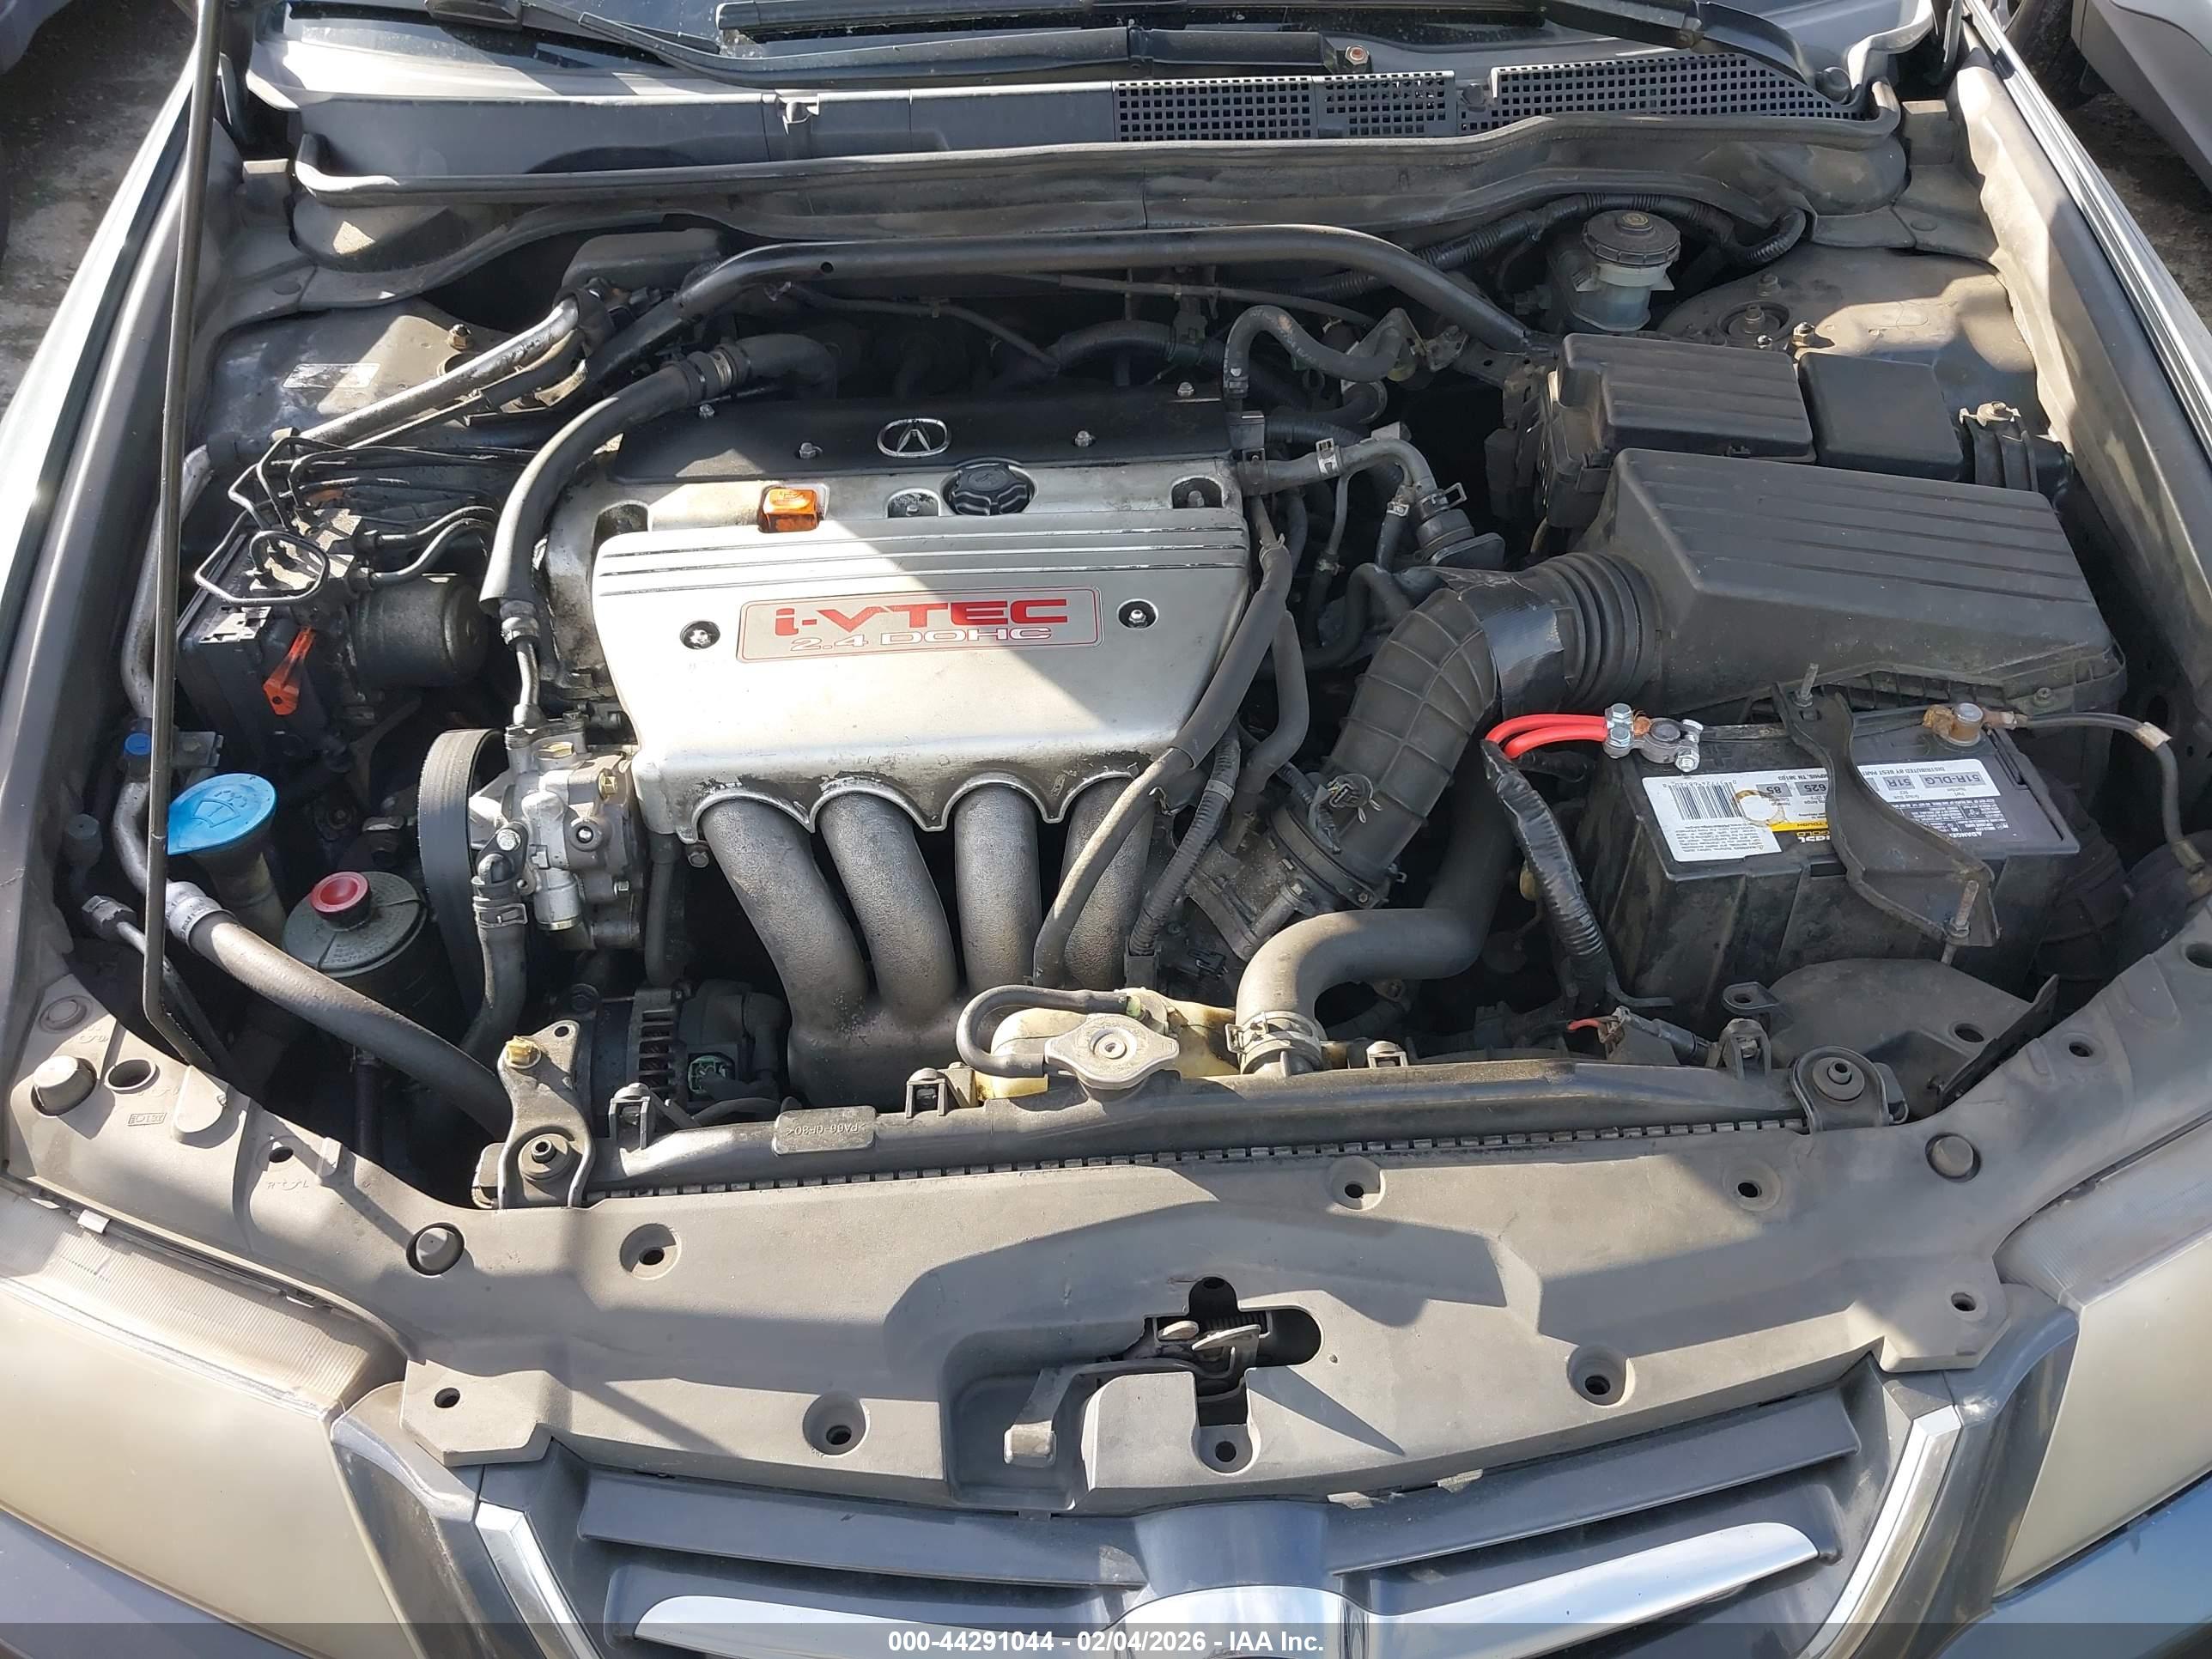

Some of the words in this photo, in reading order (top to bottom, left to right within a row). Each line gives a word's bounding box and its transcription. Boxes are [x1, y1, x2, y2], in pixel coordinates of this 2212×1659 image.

[775, 598, 1068, 636] i-VTEC
[789, 634, 869, 652] 2.4
[880, 626, 1052, 646] DOHC
[1905, 767, 1945, 775] DISTRIBUTED
[1887, 778, 1911, 787] 51R
[1925, 775, 1981, 785] 51R-DLG
